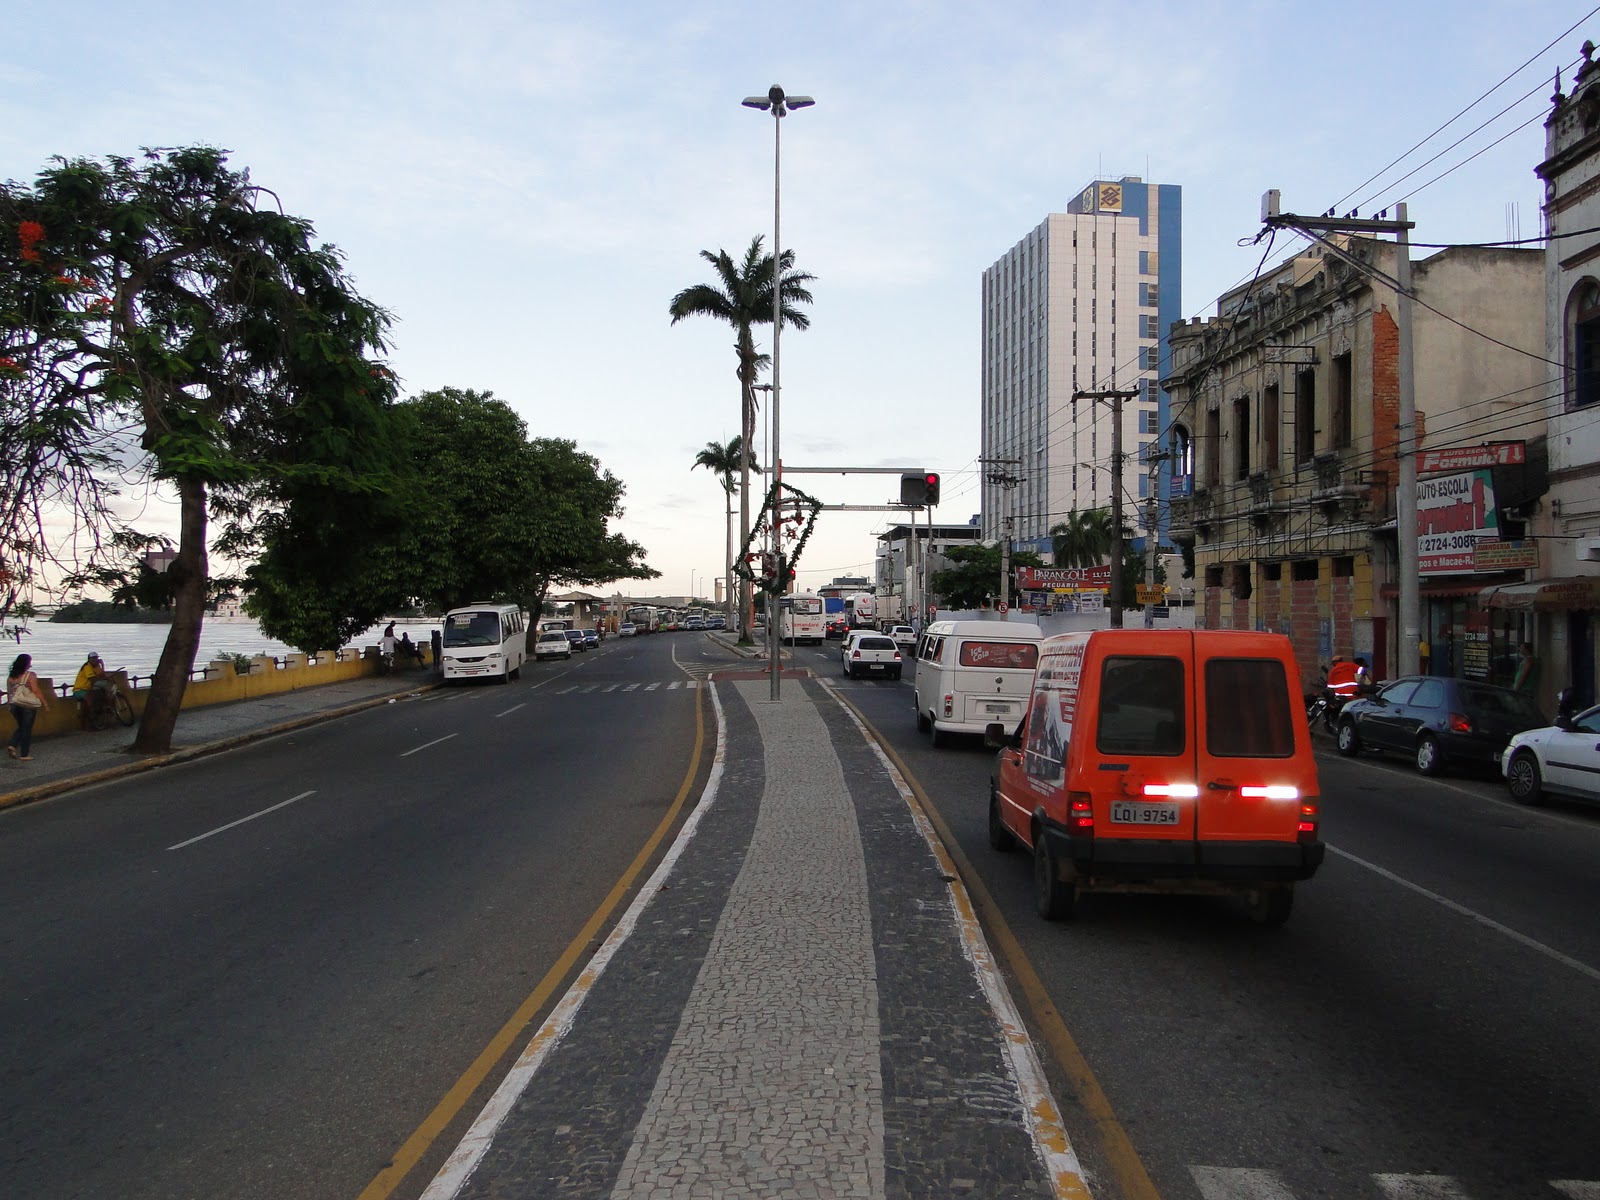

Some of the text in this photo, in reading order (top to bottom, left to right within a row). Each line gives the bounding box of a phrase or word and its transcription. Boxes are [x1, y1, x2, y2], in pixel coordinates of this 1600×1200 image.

[1417, 477, 1469, 501] AUTO ESCOLA
[1425, 535, 1475, 552] 2724-3086
